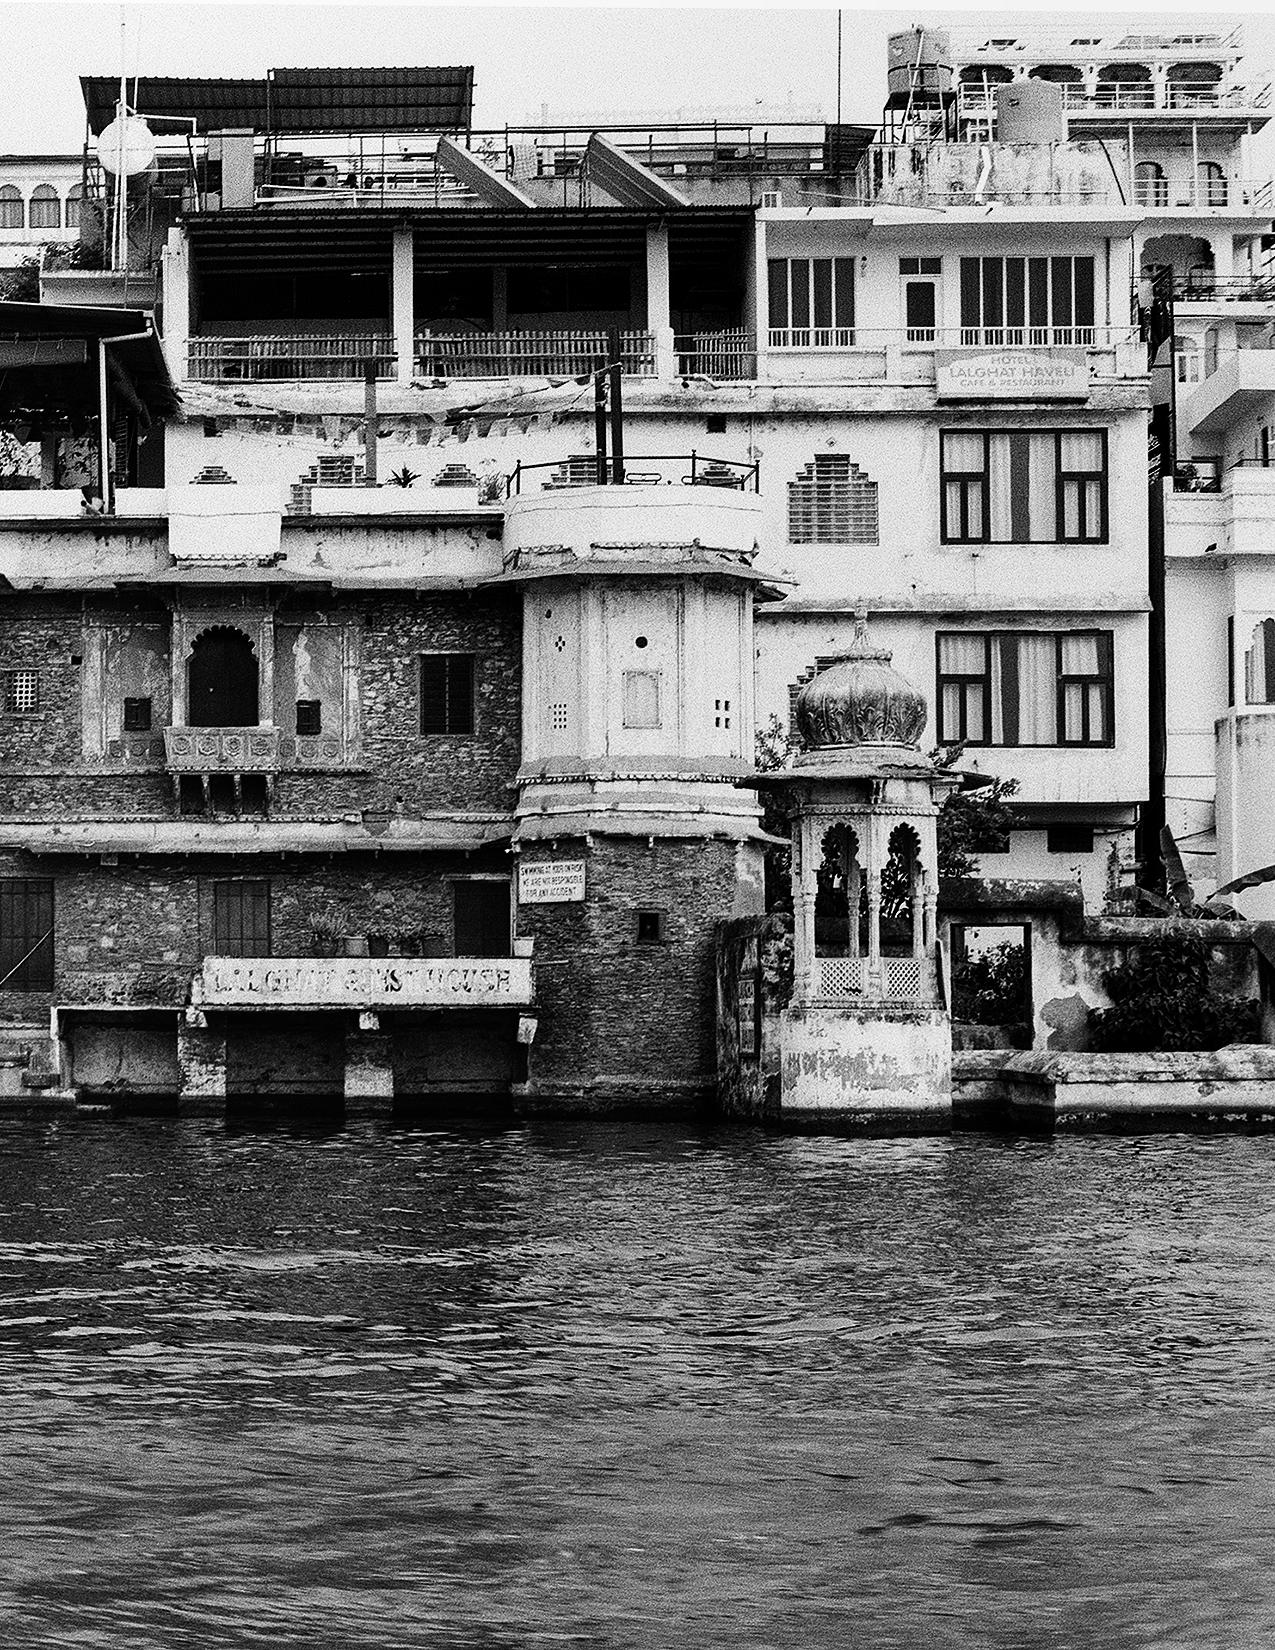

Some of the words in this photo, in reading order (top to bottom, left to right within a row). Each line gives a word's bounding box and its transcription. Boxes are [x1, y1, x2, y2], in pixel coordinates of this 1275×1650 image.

[990, 355, 1035, 366] HOTEL
[949, 366, 1017, 379] LALGHAT
[1022, 366, 1075, 378] HAVELI
[987, 379, 998, 387] &
[999, 379, 1065, 387] RESTAURANT
